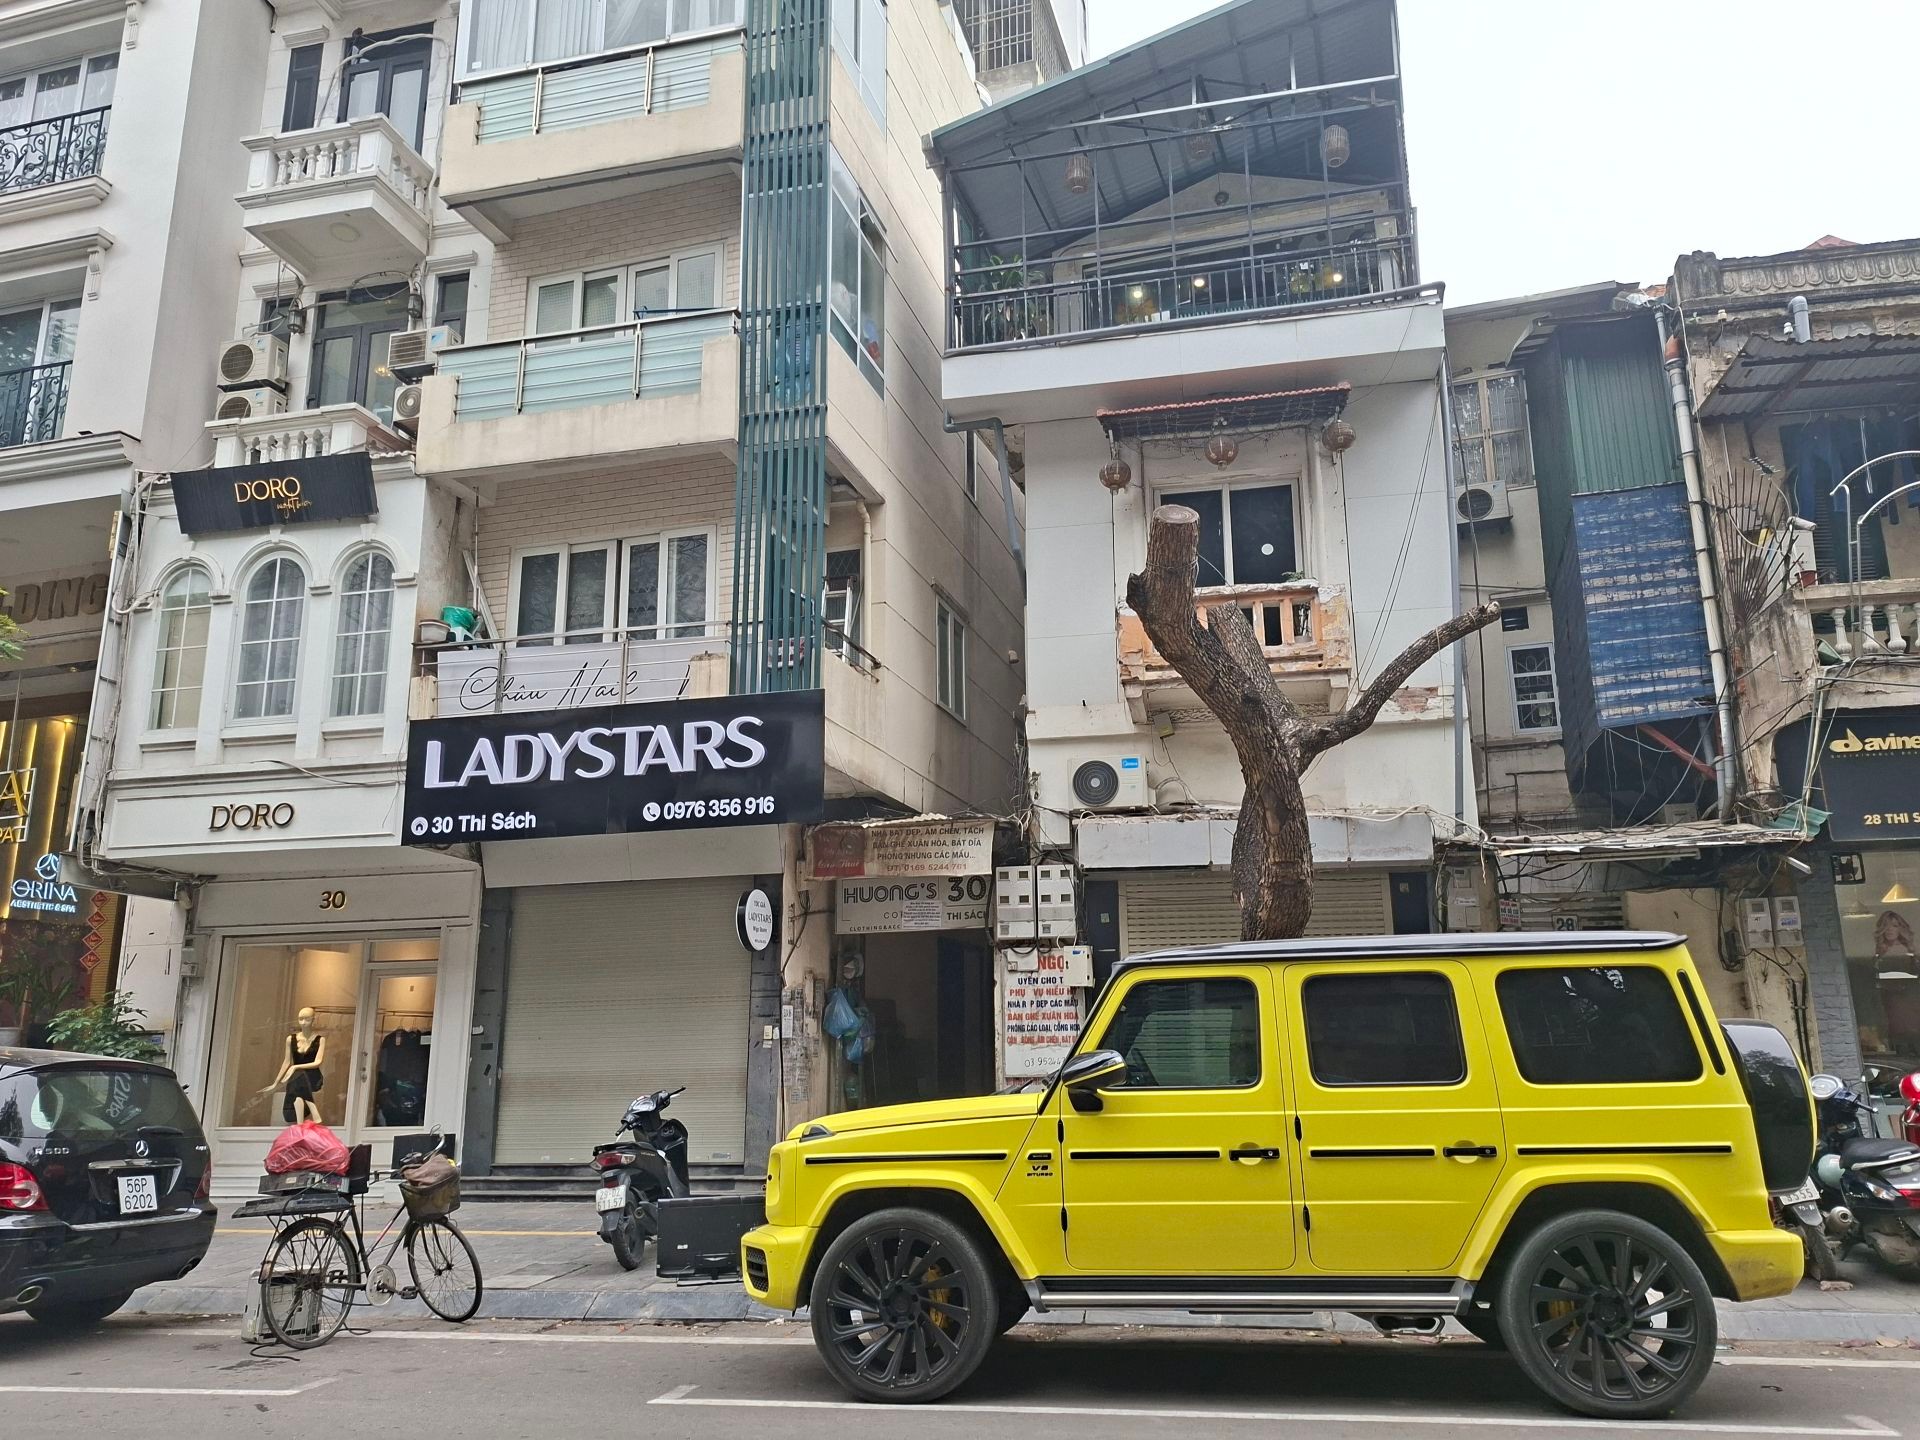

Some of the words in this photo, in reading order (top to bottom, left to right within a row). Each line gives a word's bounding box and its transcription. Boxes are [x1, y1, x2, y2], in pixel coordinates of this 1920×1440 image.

[234, 476, 300, 503] D'ORO
[459, 666, 548, 711] Châu
[555, 658, 638, 711] Nail
[423, 715, 767, 790] LADYSTARS
[208, 802, 295, 832] D'ORO
[663, 799, 706, 820] 0976
[708, 797, 742, 817] 356
[744, 796, 775, 816] 916
[1863, 814, 1882, 825] 28
[1884, 812, 1910, 824] THI
[431, 816, 454, 834] 30
[458, 813, 486, 832] Thi
[491, 811, 537, 832] Sách
[947, 875, 987, 902] 30
[319, 890, 347, 911] 30
[946, 911, 962, 921] THI
[1556, 917, 1575, 931] 28
[1041, 976, 1057, 984] CHO
[126, 1177, 148, 1194] 56P
[124, 1193, 153, 1210] 6202
